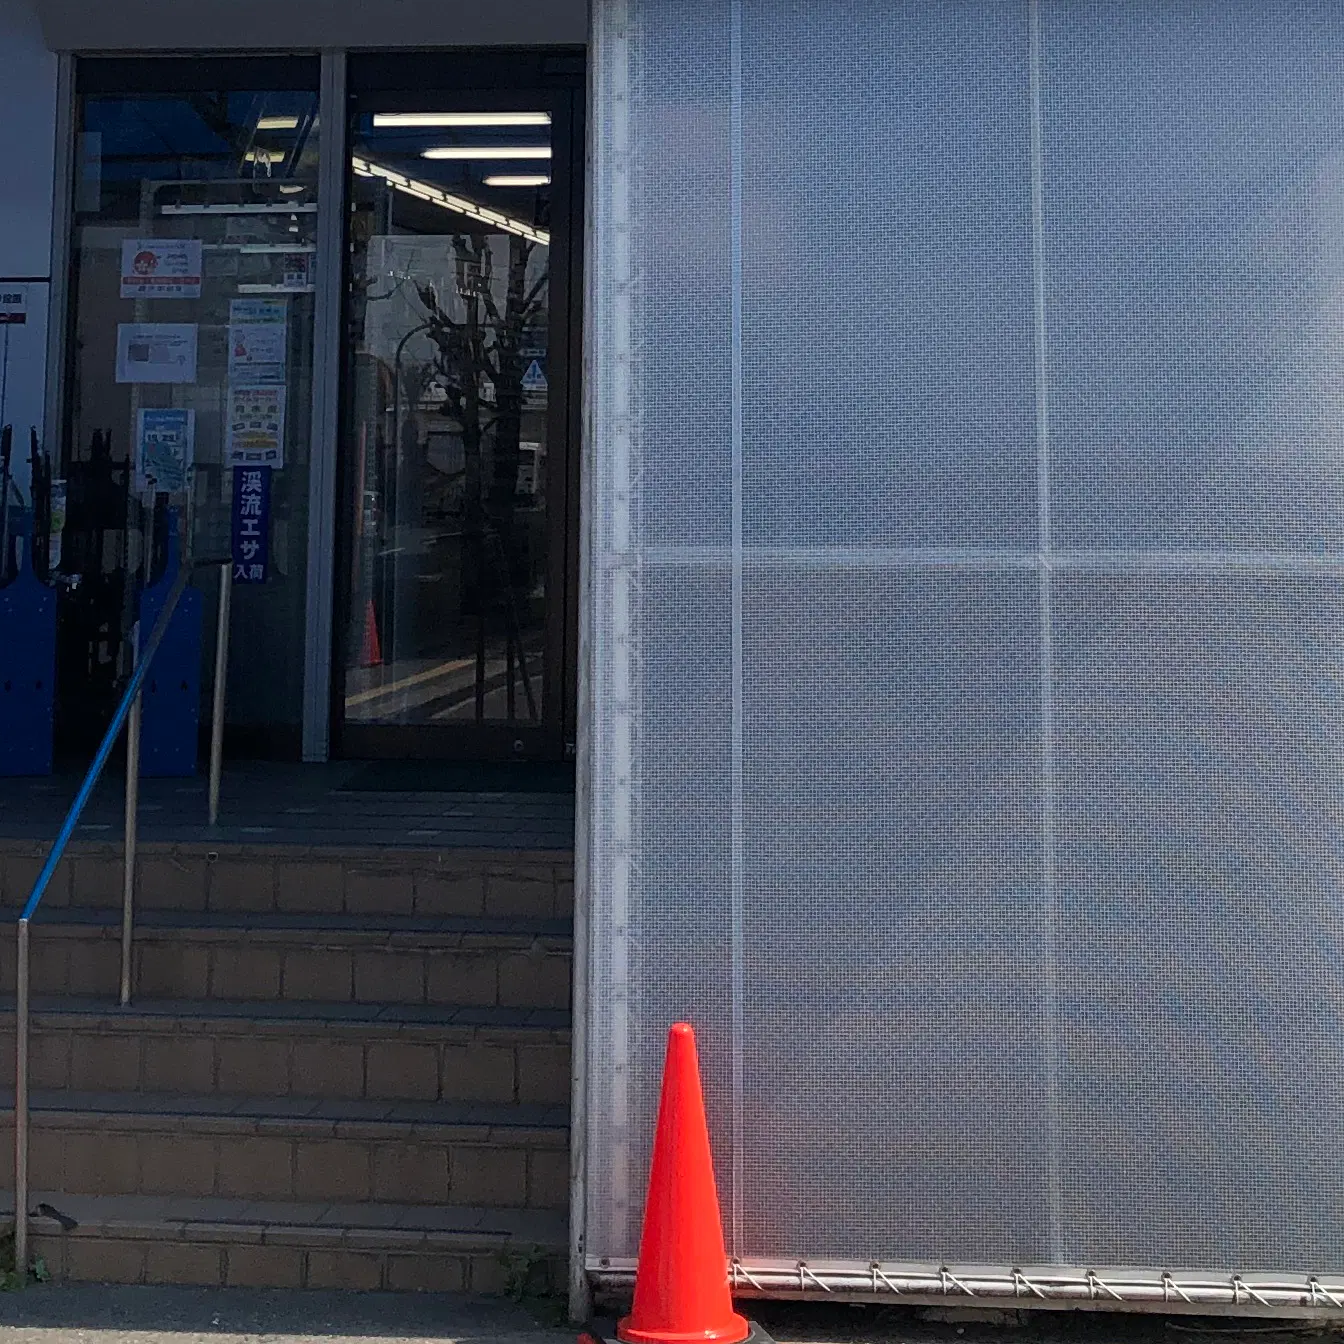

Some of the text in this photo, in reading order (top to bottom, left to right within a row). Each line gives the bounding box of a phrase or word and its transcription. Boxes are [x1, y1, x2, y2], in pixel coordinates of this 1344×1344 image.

[239, 470, 263, 561] 渓流エサ
[233, 564, 265, 580] 入荷
